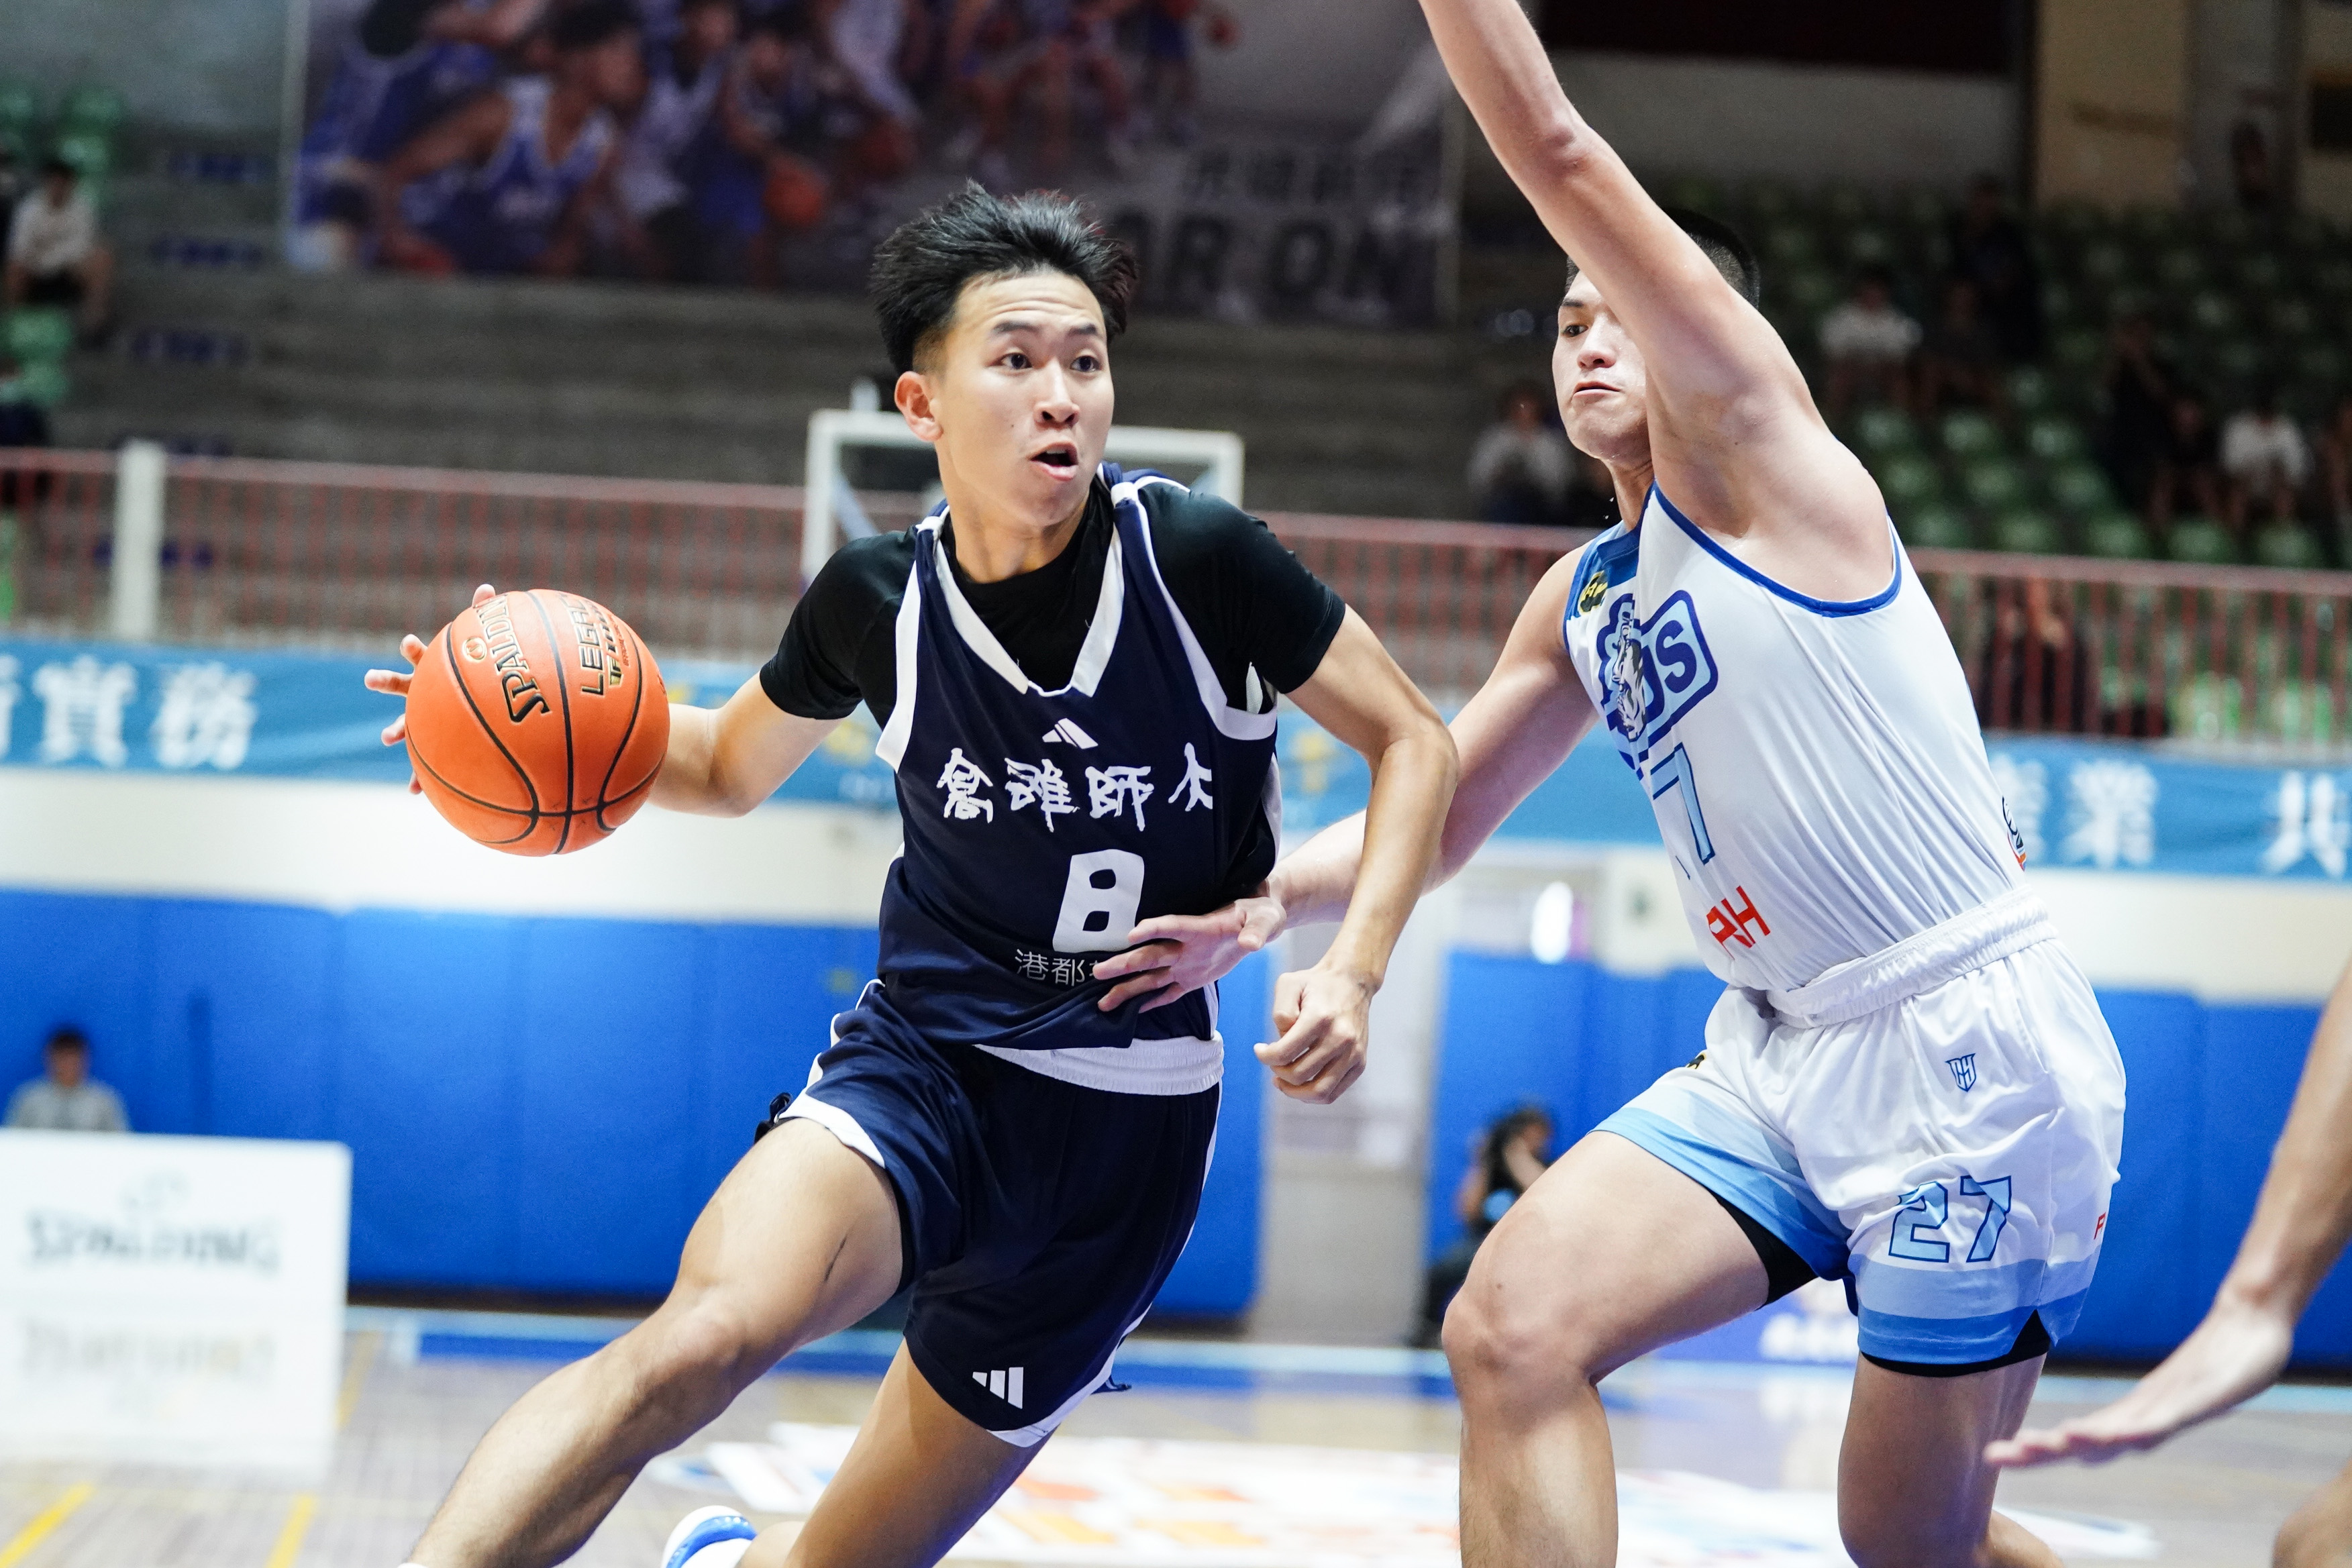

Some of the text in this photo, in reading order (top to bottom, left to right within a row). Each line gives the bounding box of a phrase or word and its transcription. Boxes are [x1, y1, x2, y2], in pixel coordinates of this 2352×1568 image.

[472, 593, 550, 723] SPALDIN
[558, 593, 605, 696] LEGAC
[0, 654, 259, 770] 實務
[1052, 848, 1145, 953] 8
[1014, 948, 1101, 987] 港都
[1888, 1175, 2012, 1264] 27
